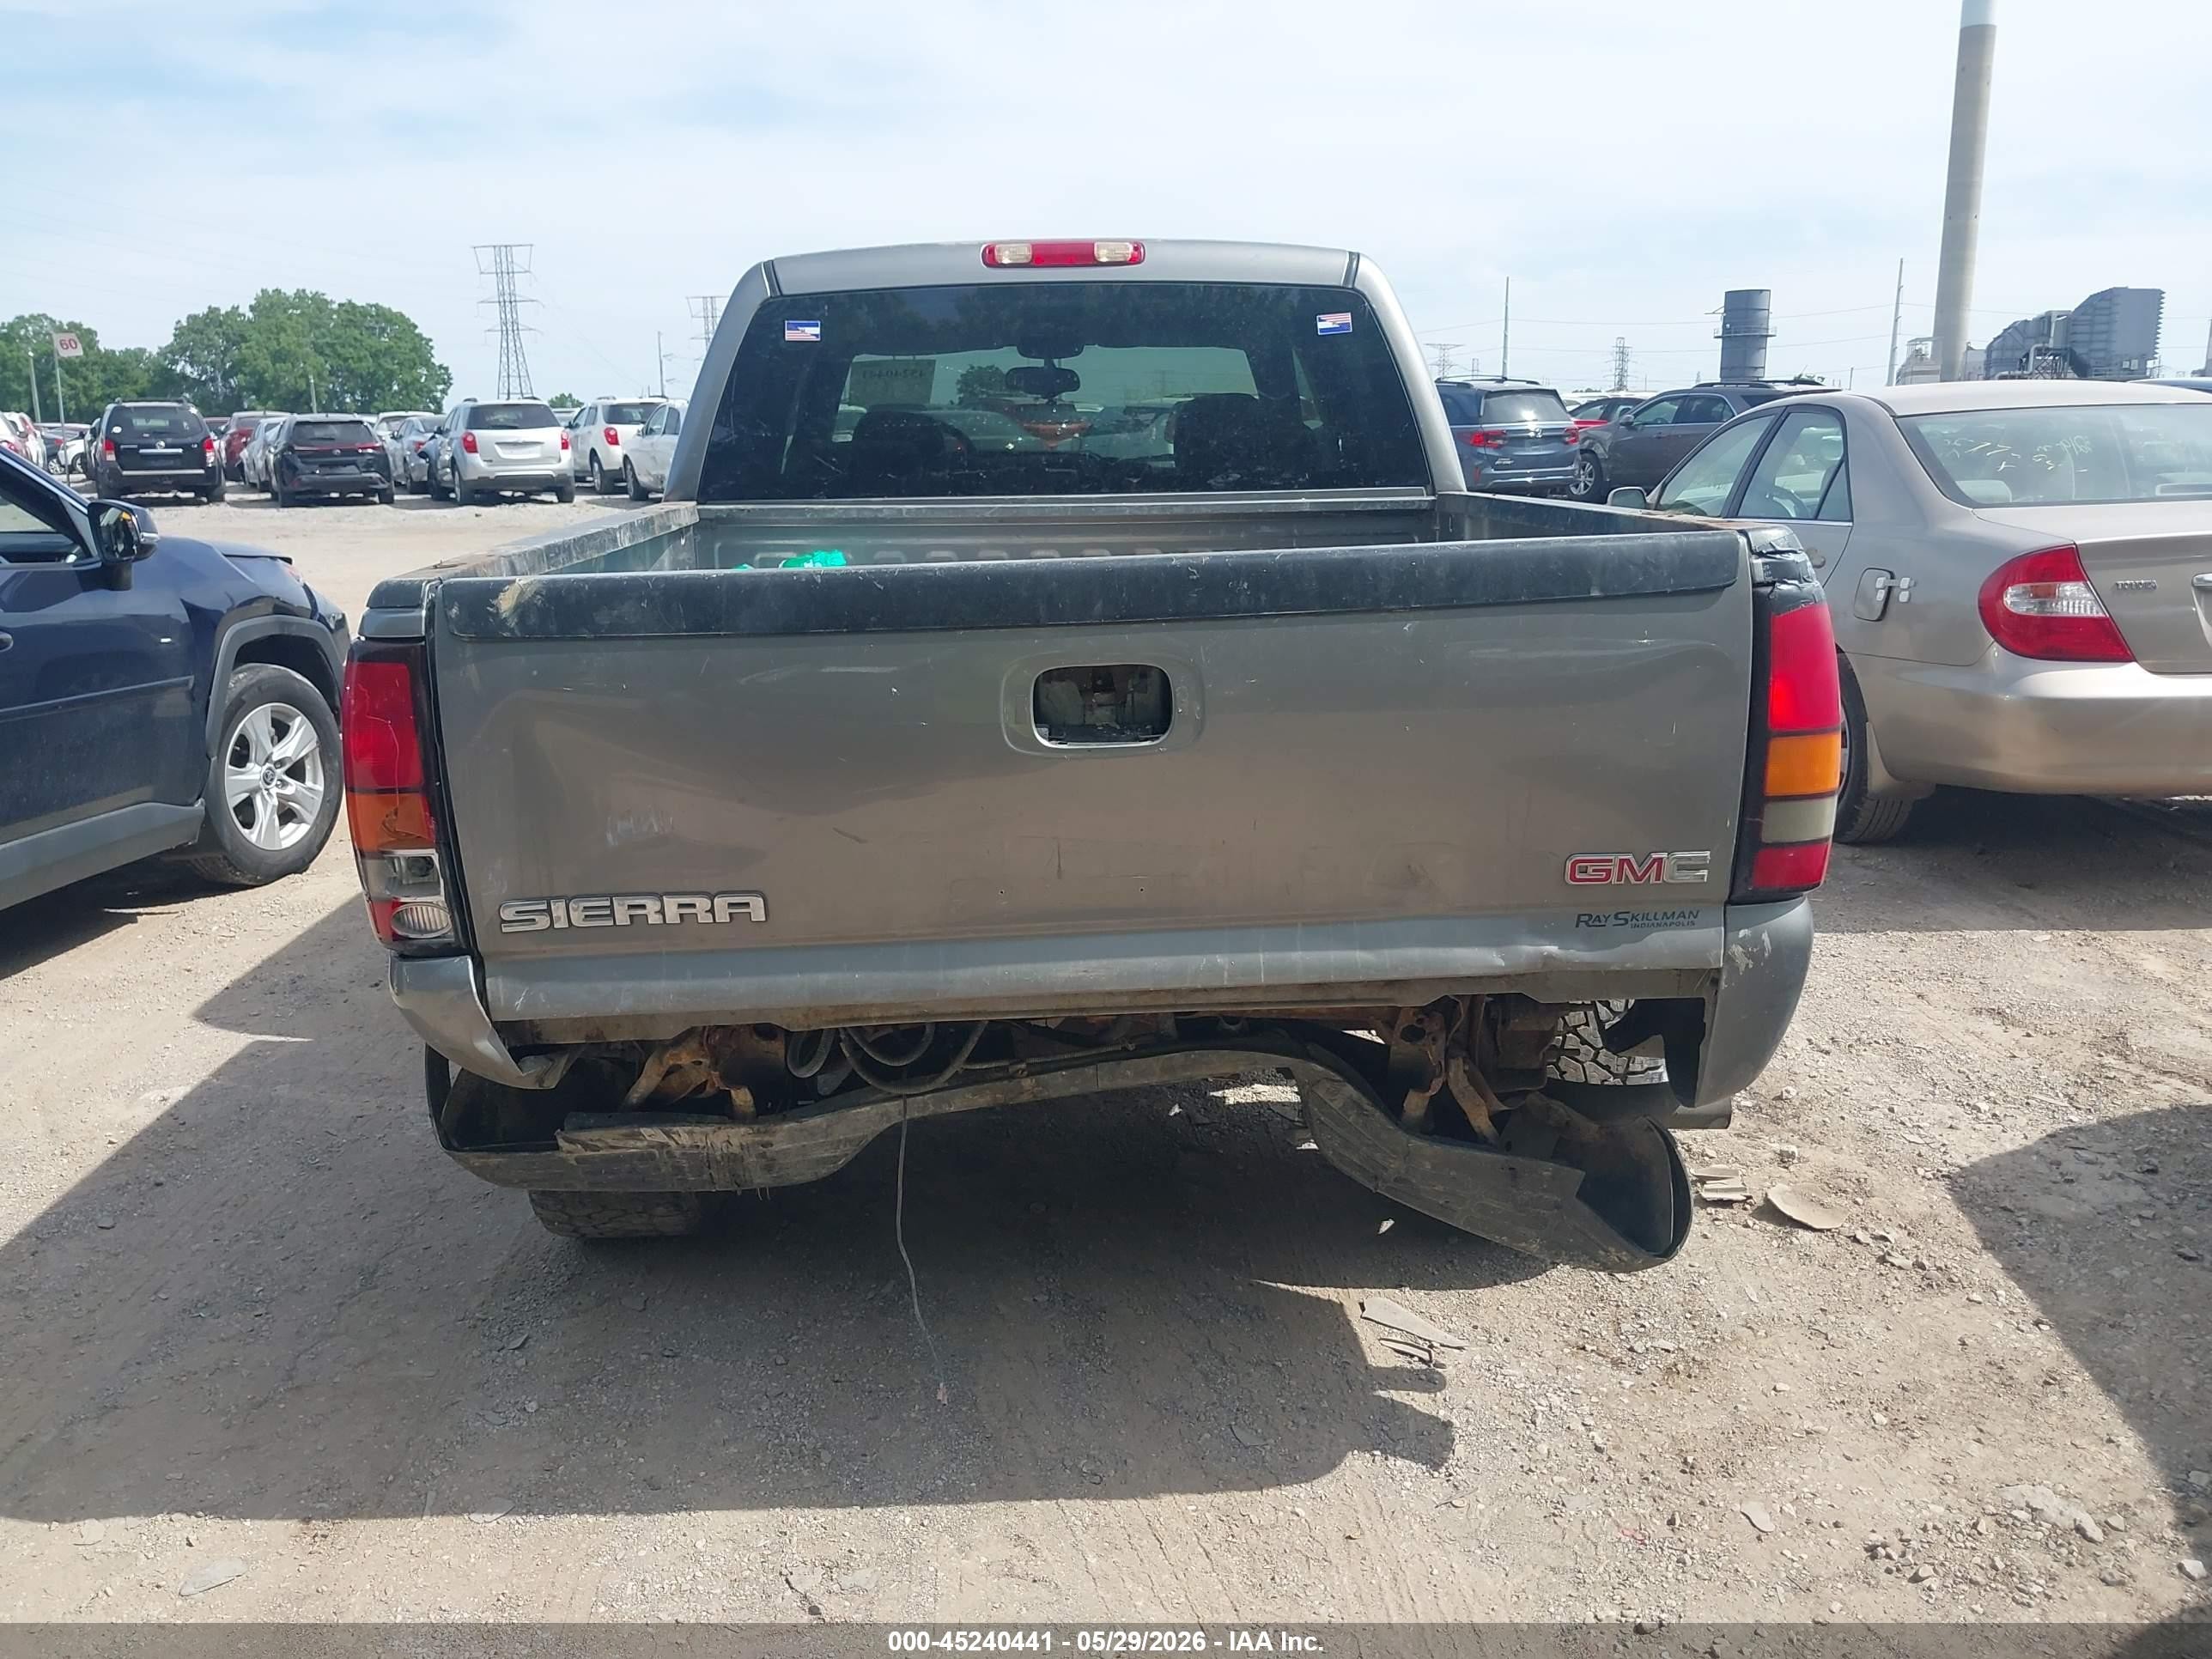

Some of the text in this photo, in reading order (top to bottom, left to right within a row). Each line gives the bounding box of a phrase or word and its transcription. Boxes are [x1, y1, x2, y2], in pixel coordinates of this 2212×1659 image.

[59, 338, 78, 350] 60
[1565, 850, 1711, 884] GMC
[498, 890, 767, 933] SIERRA
[1576, 910, 1700, 928] RAY SKILLMAN
[1631, 920, 1696, 928] INDIANAPOLIS
